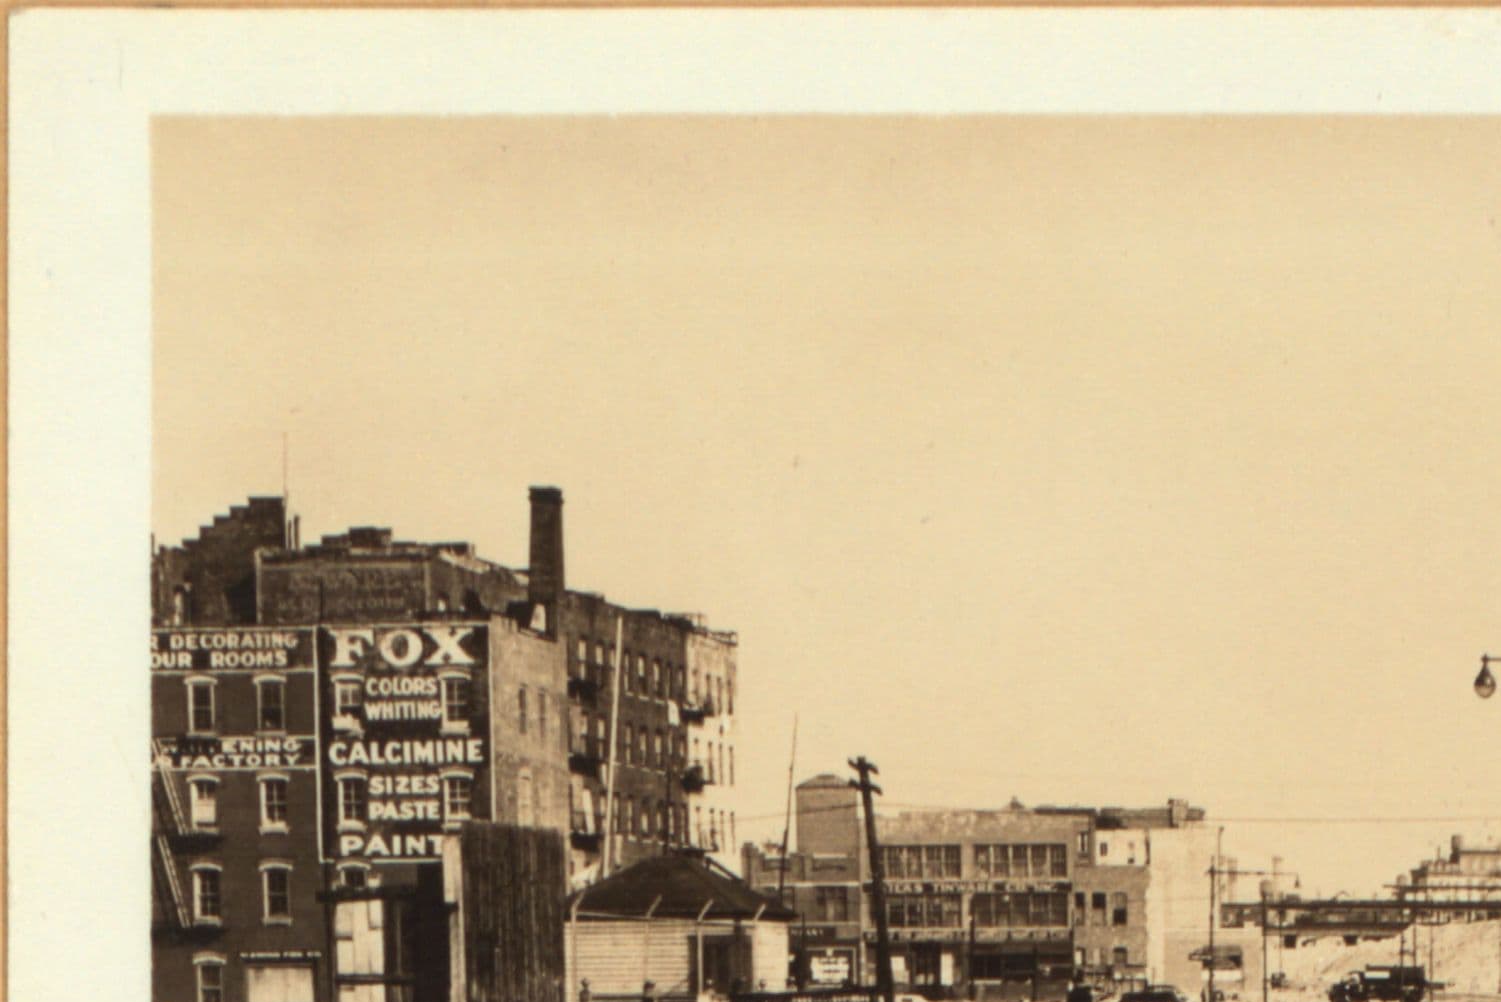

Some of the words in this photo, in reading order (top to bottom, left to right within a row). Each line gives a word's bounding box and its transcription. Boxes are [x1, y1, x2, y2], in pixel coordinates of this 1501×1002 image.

[170, 632, 299, 650] DECORATING
[331, 628, 475, 669] FOX
[211, 650, 288, 668] ROOMS
[366, 676, 438, 697] COLORS
[365, 700, 442, 720] WHITING
[181, 753, 303, 768] FACTORY
[329, 738, 484, 765] CALCIMINE
[368, 774, 440, 796] SIZES
[368, 799, 440, 821] PASTE
